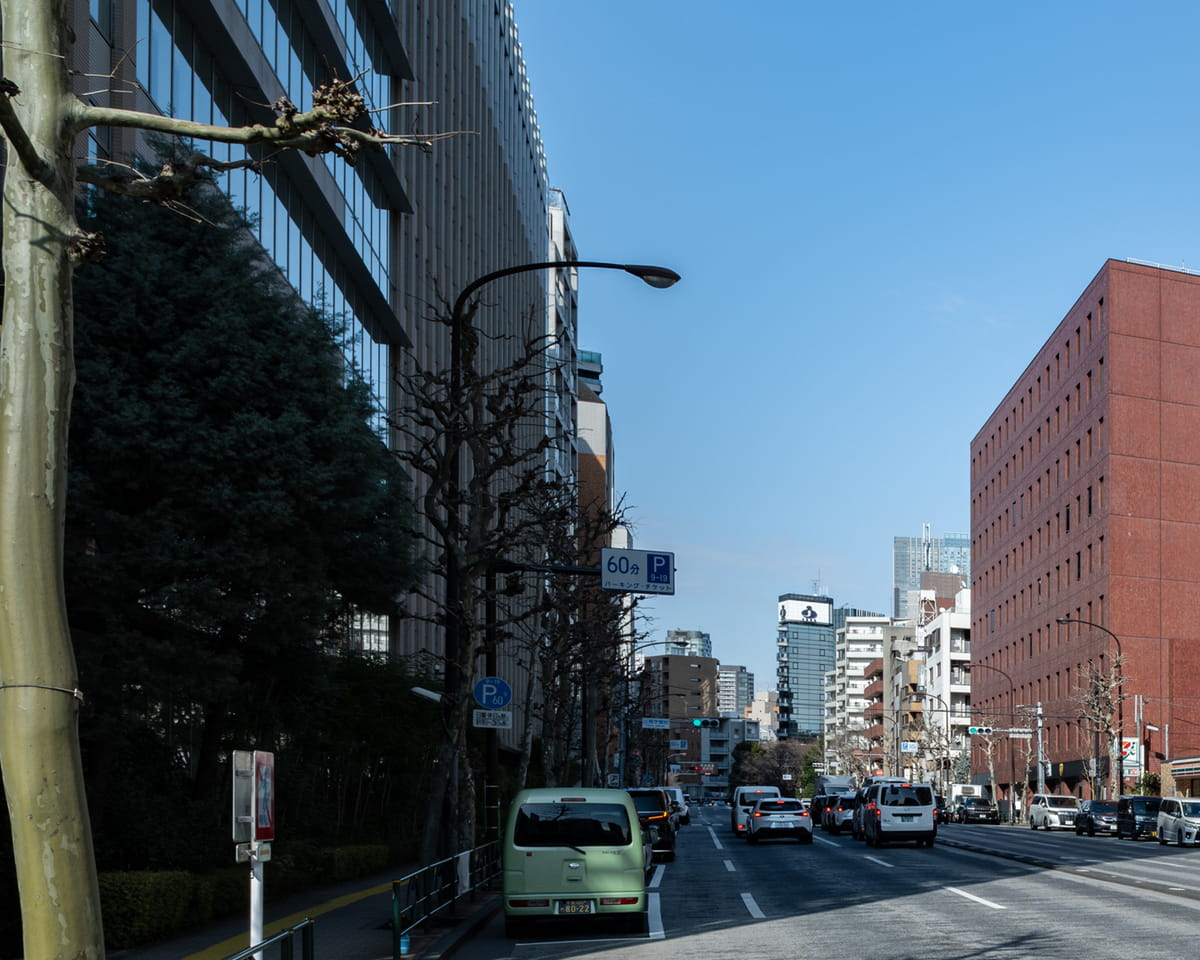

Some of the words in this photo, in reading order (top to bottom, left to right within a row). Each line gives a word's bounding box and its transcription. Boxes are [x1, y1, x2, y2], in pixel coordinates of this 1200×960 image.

[608, 556, 640, 575] 60分
[654, 557, 665, 572] P
[482, 684, 497, 704] P
